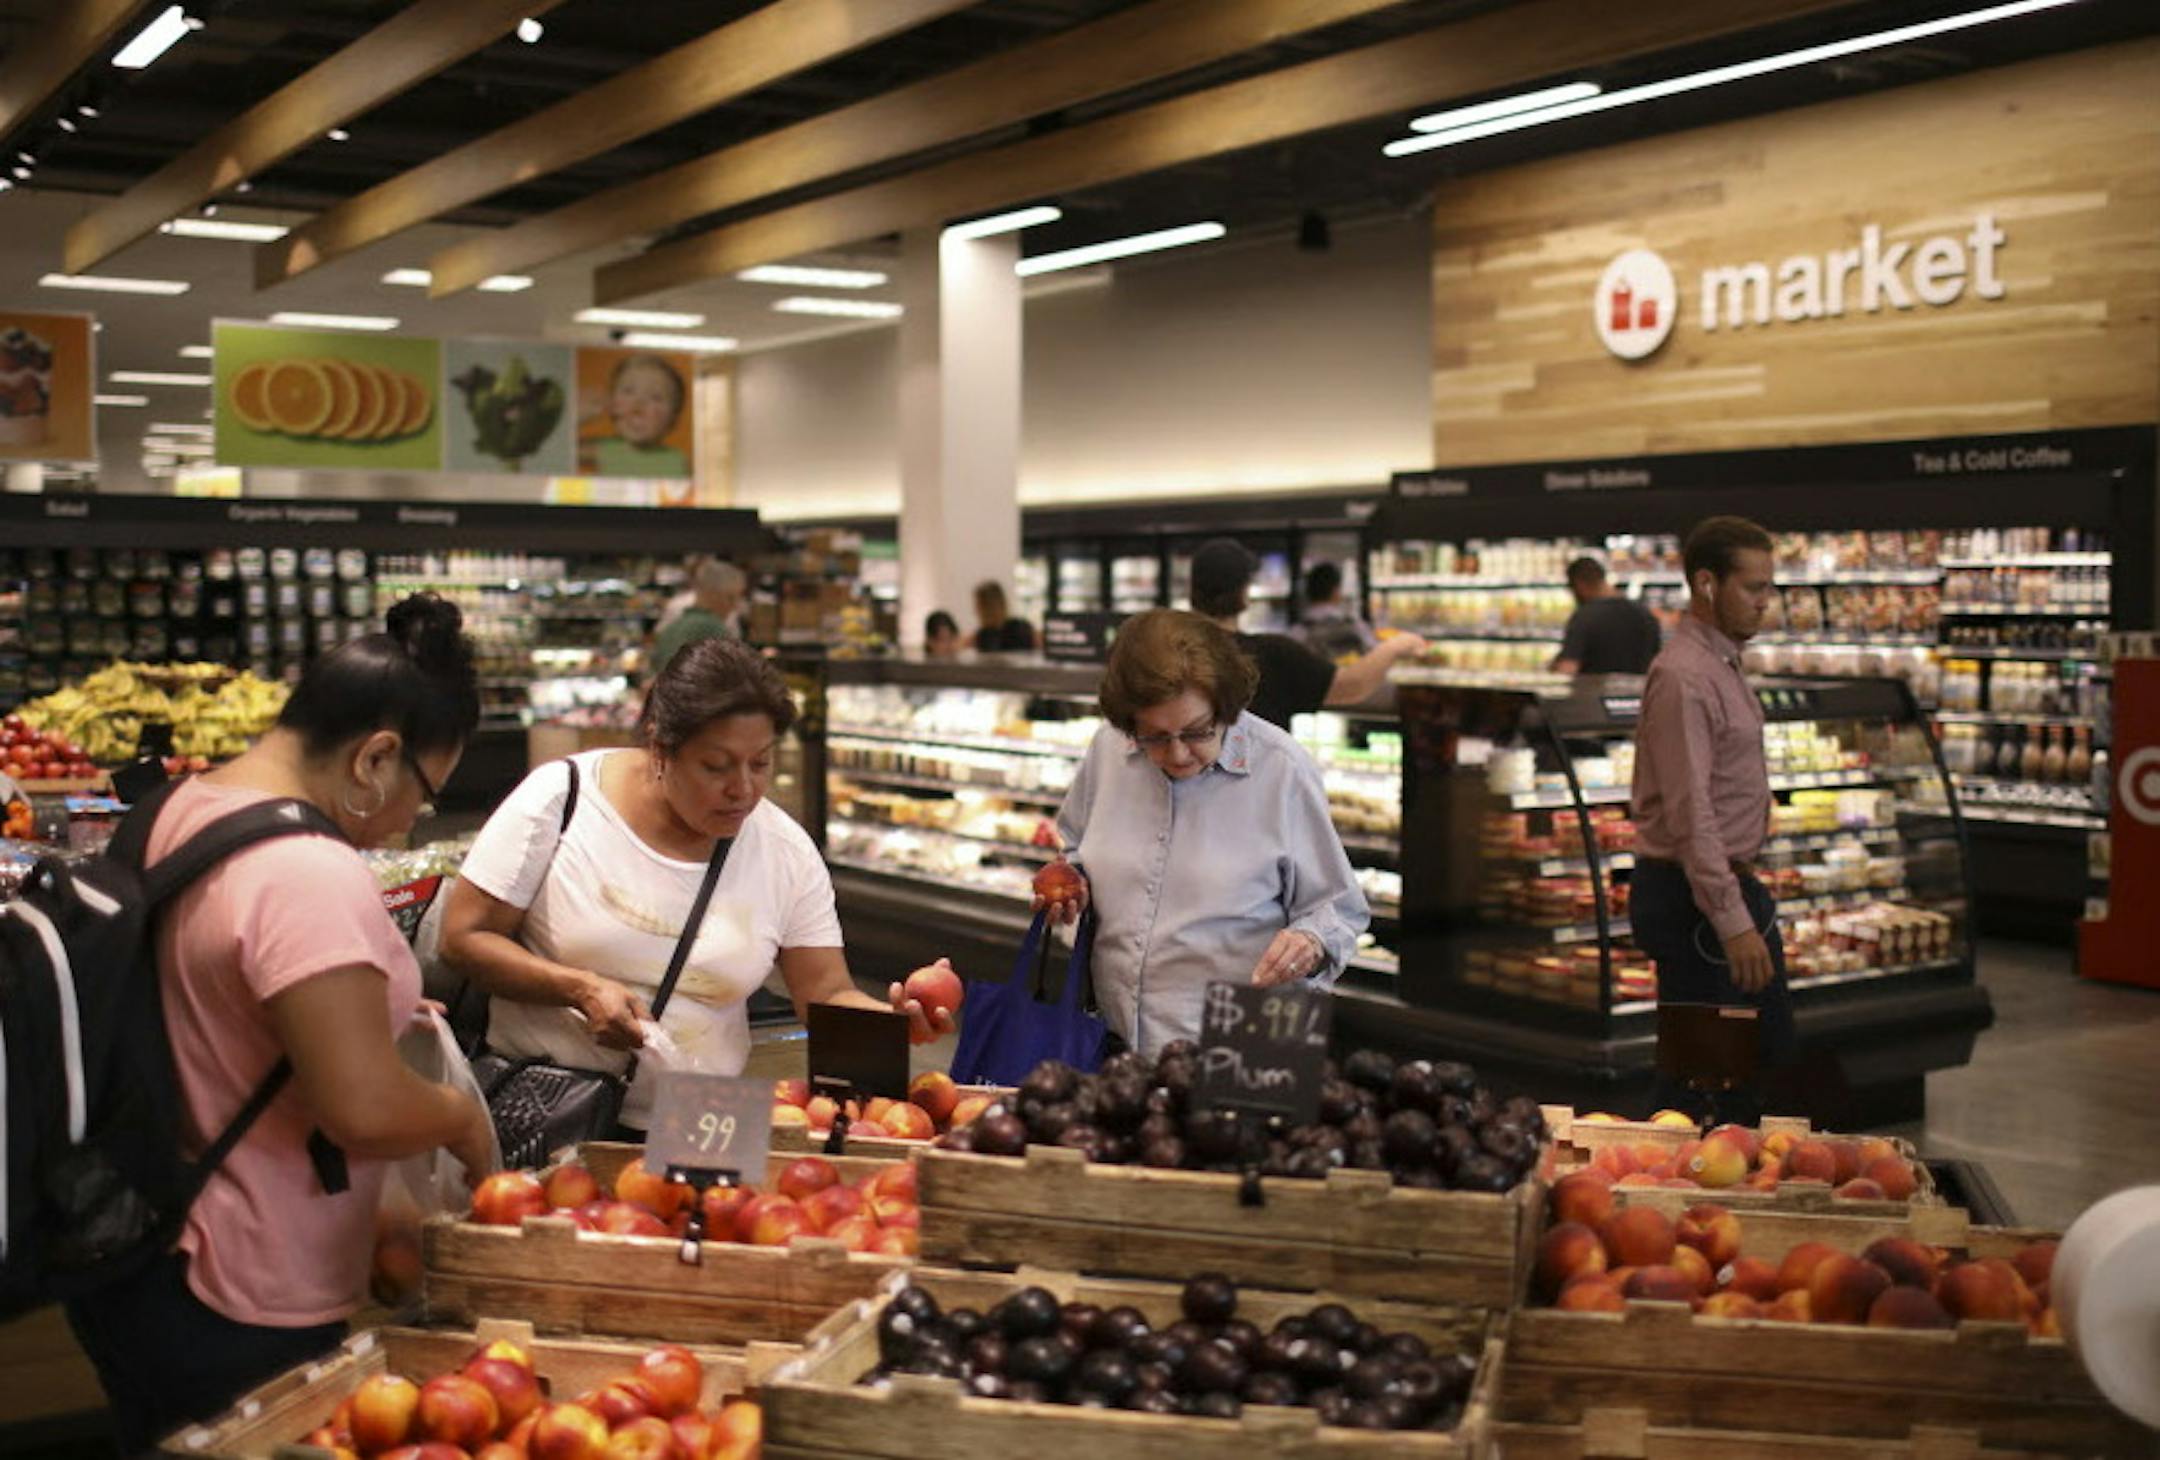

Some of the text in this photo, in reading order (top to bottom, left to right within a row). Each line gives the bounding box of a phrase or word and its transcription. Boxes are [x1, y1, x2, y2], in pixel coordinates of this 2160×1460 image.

[1701, 213, 2006, 331] market
[1965, 449, 2007, 471] Cold
[2009, 445, 2072, 468] Coffee
[383, 889, 416, 909] Sale
[1201, 1046, 1295, 1091] Plum
[687, 1112, 736, 1152] .99
